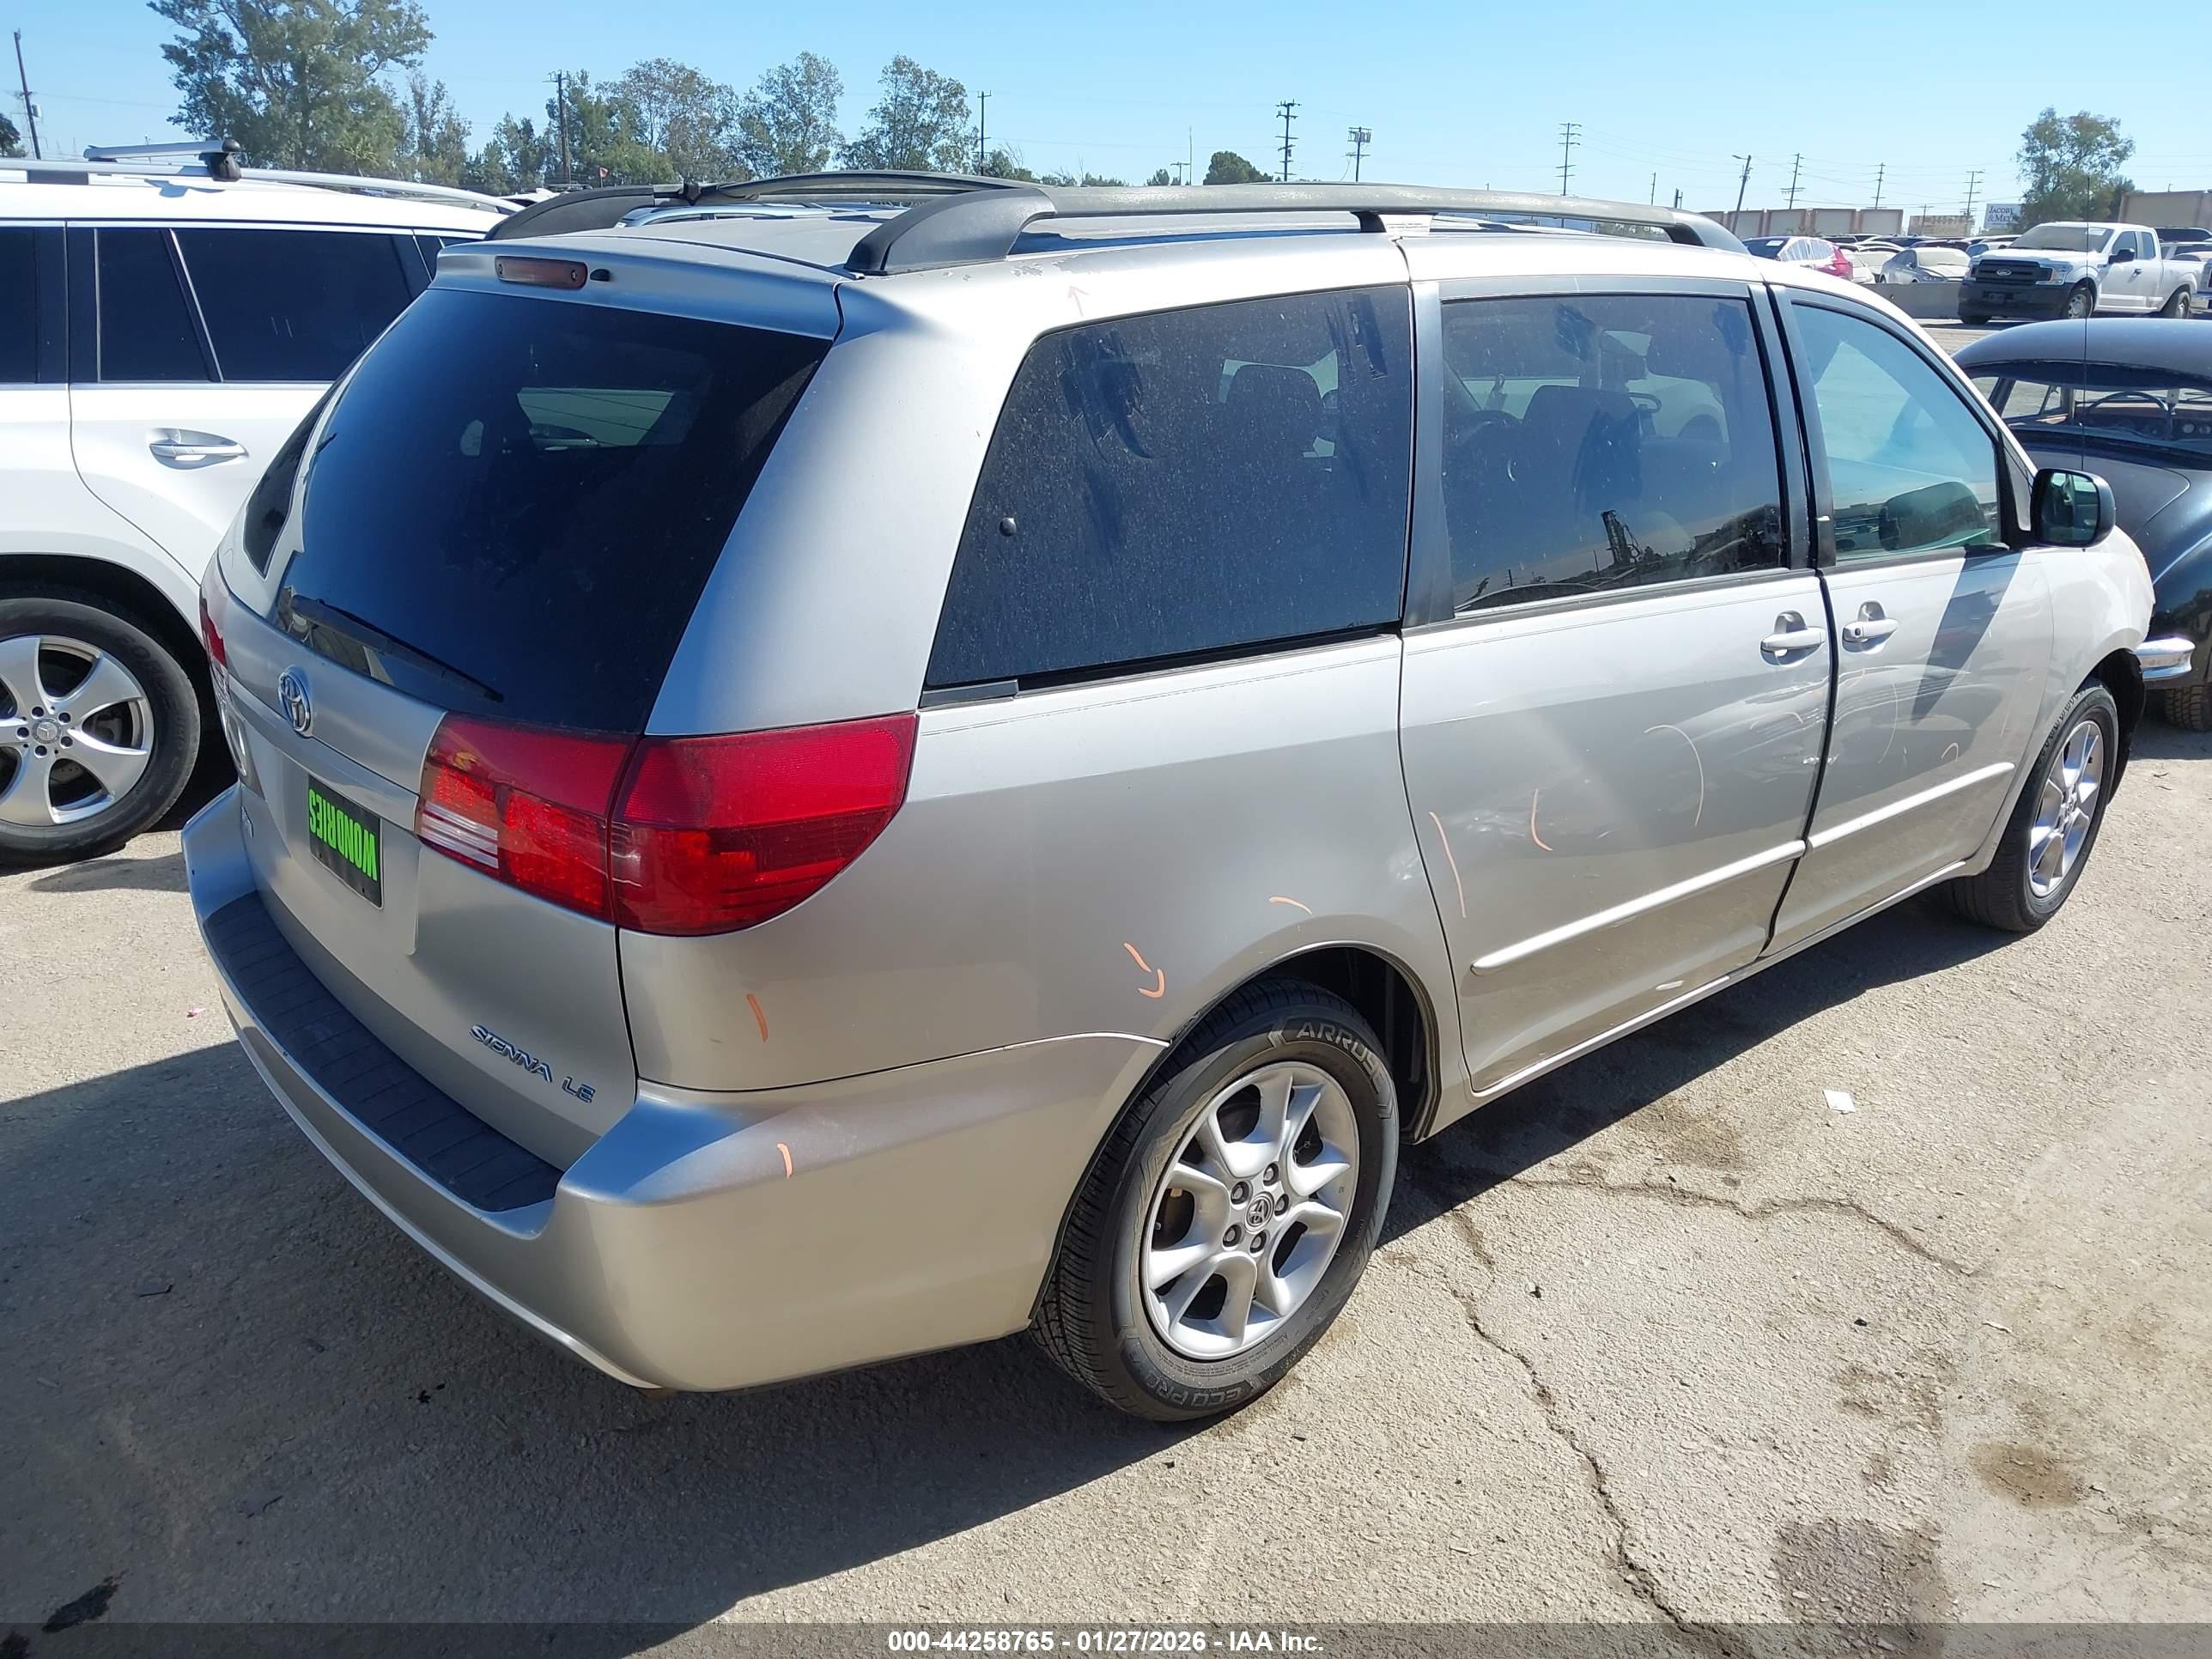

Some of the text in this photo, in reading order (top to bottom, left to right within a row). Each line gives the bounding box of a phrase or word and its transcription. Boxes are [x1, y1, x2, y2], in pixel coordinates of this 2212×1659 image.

[1989, 205, 2014, 214] JACOBY
[308, 788, 378, 882] WONDRIES
[468, 1024, 596, 1104] SIENNA LE
